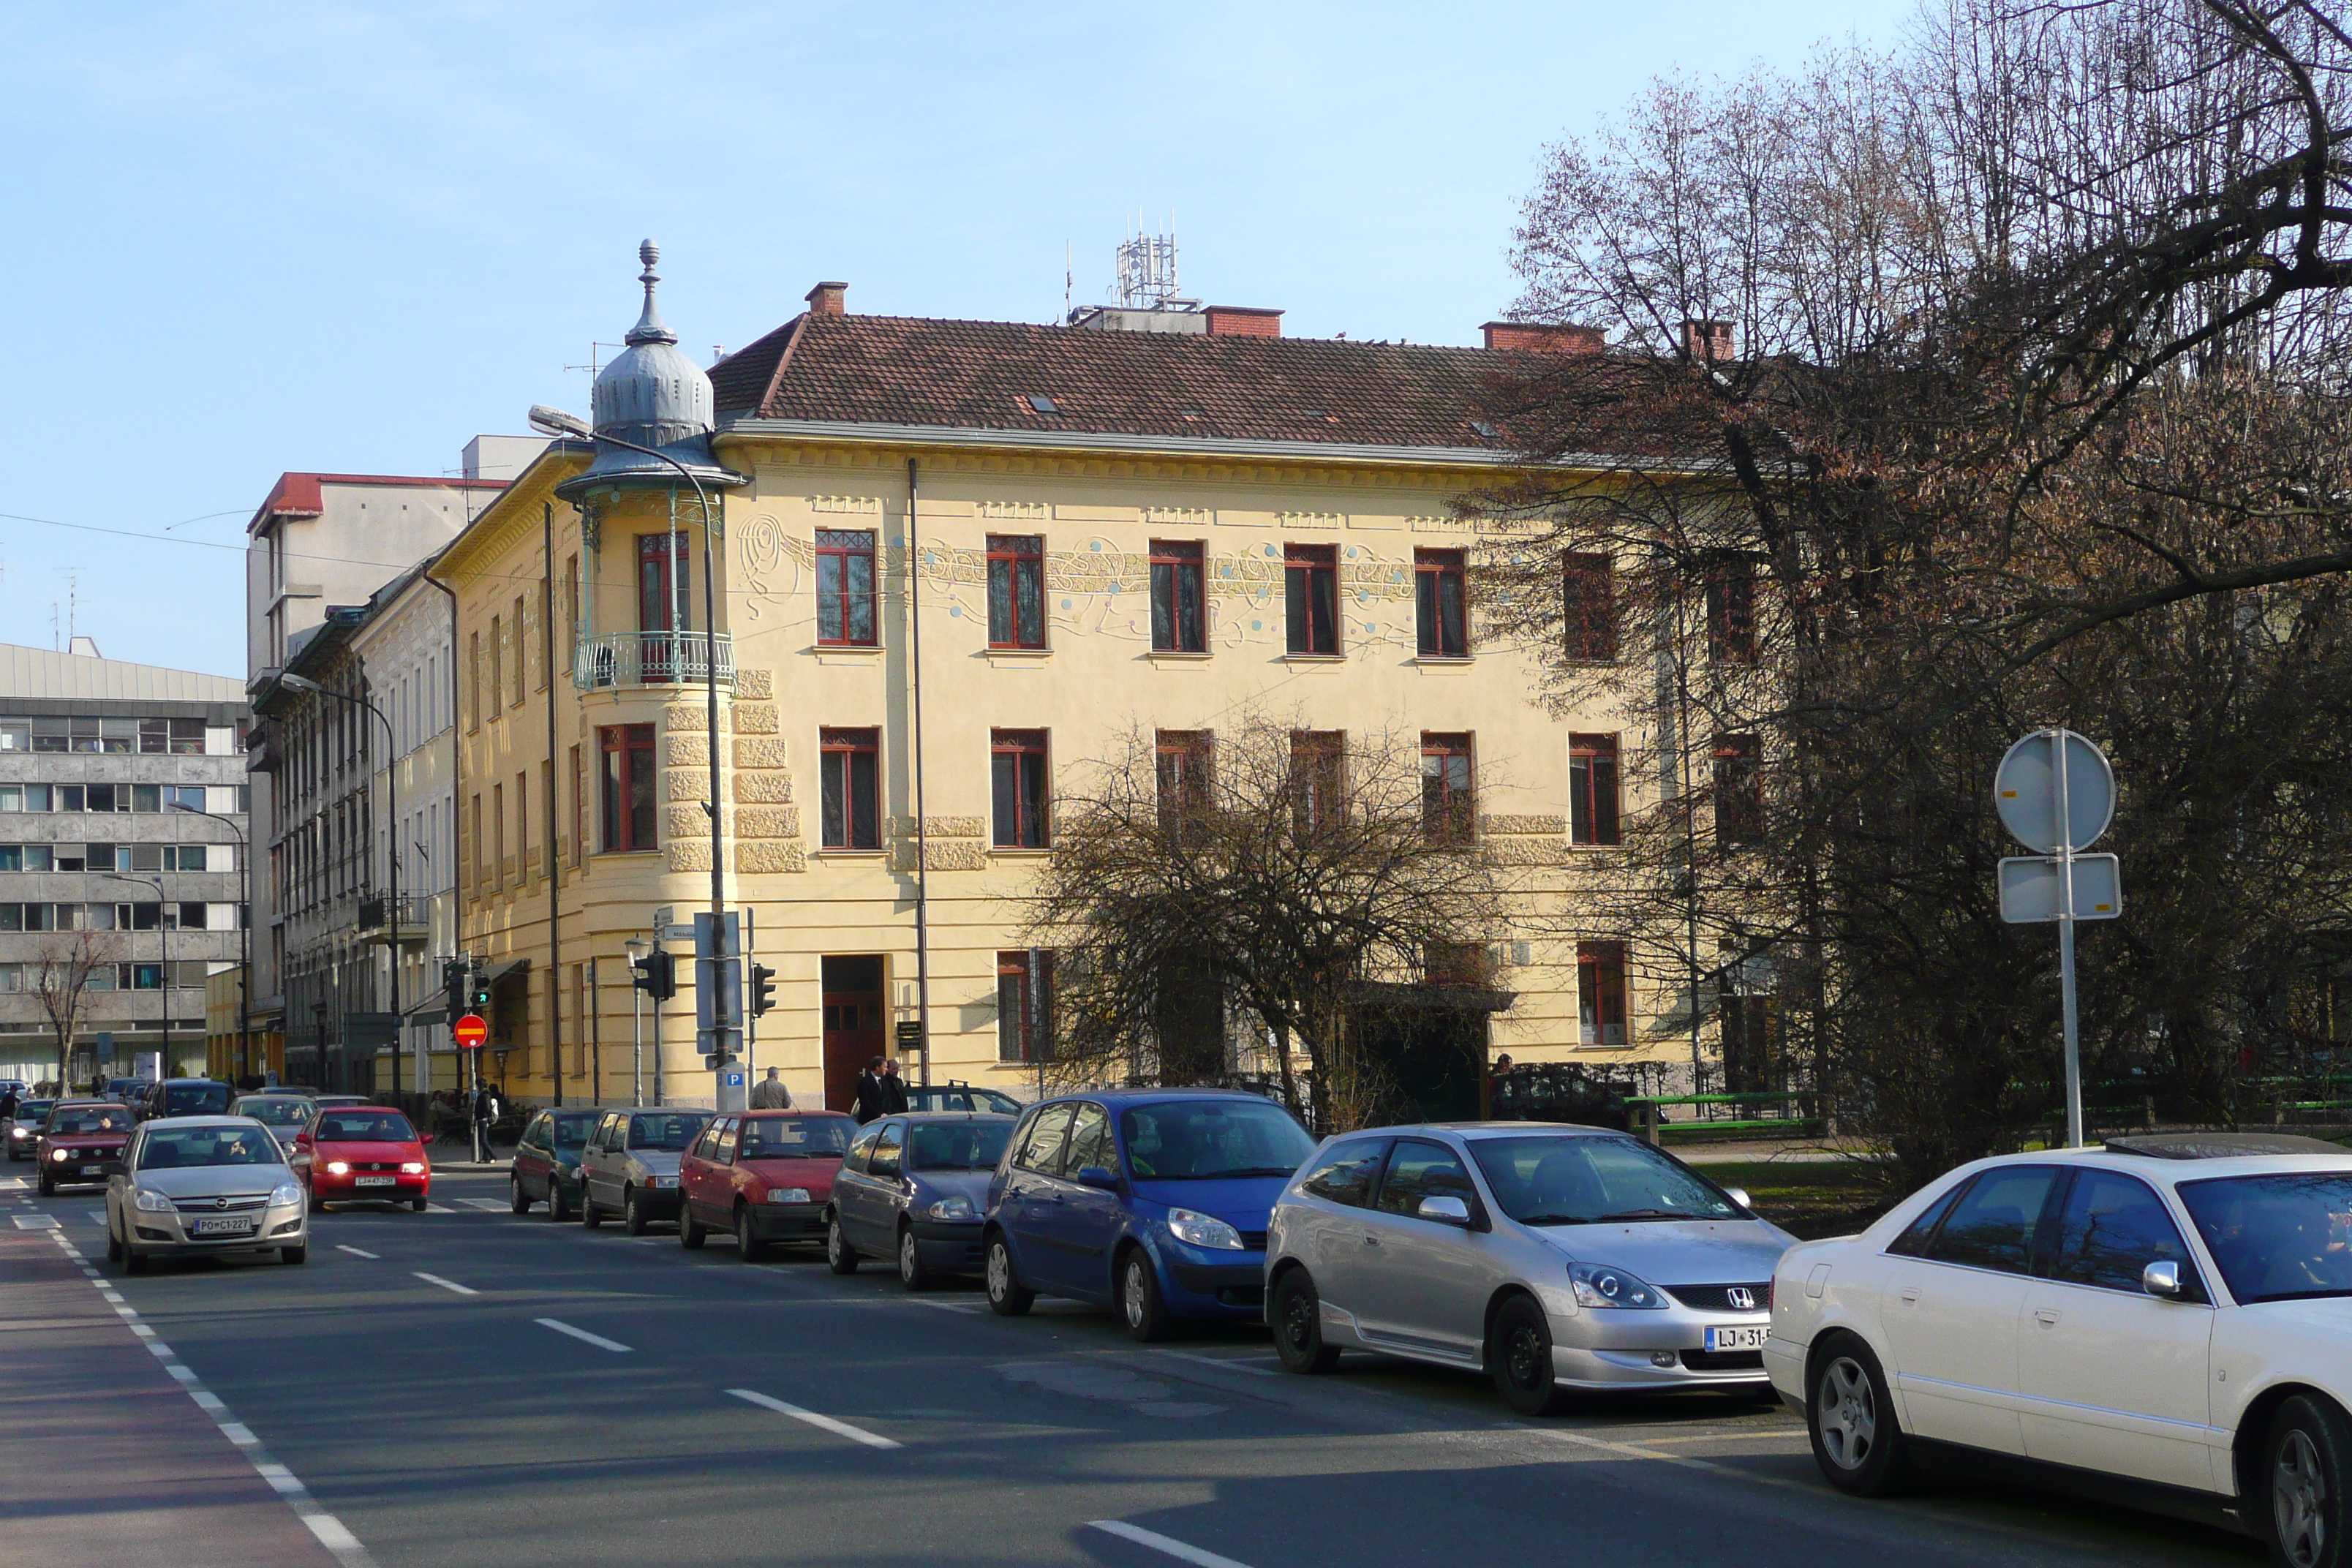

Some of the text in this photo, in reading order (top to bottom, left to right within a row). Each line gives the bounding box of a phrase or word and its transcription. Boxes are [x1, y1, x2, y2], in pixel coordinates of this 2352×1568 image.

[731, 1074, 739, 1085] P
[201, 1219, 248, 1230] PO C1-227
[1719, 1330, 1736, 1346] LJ
